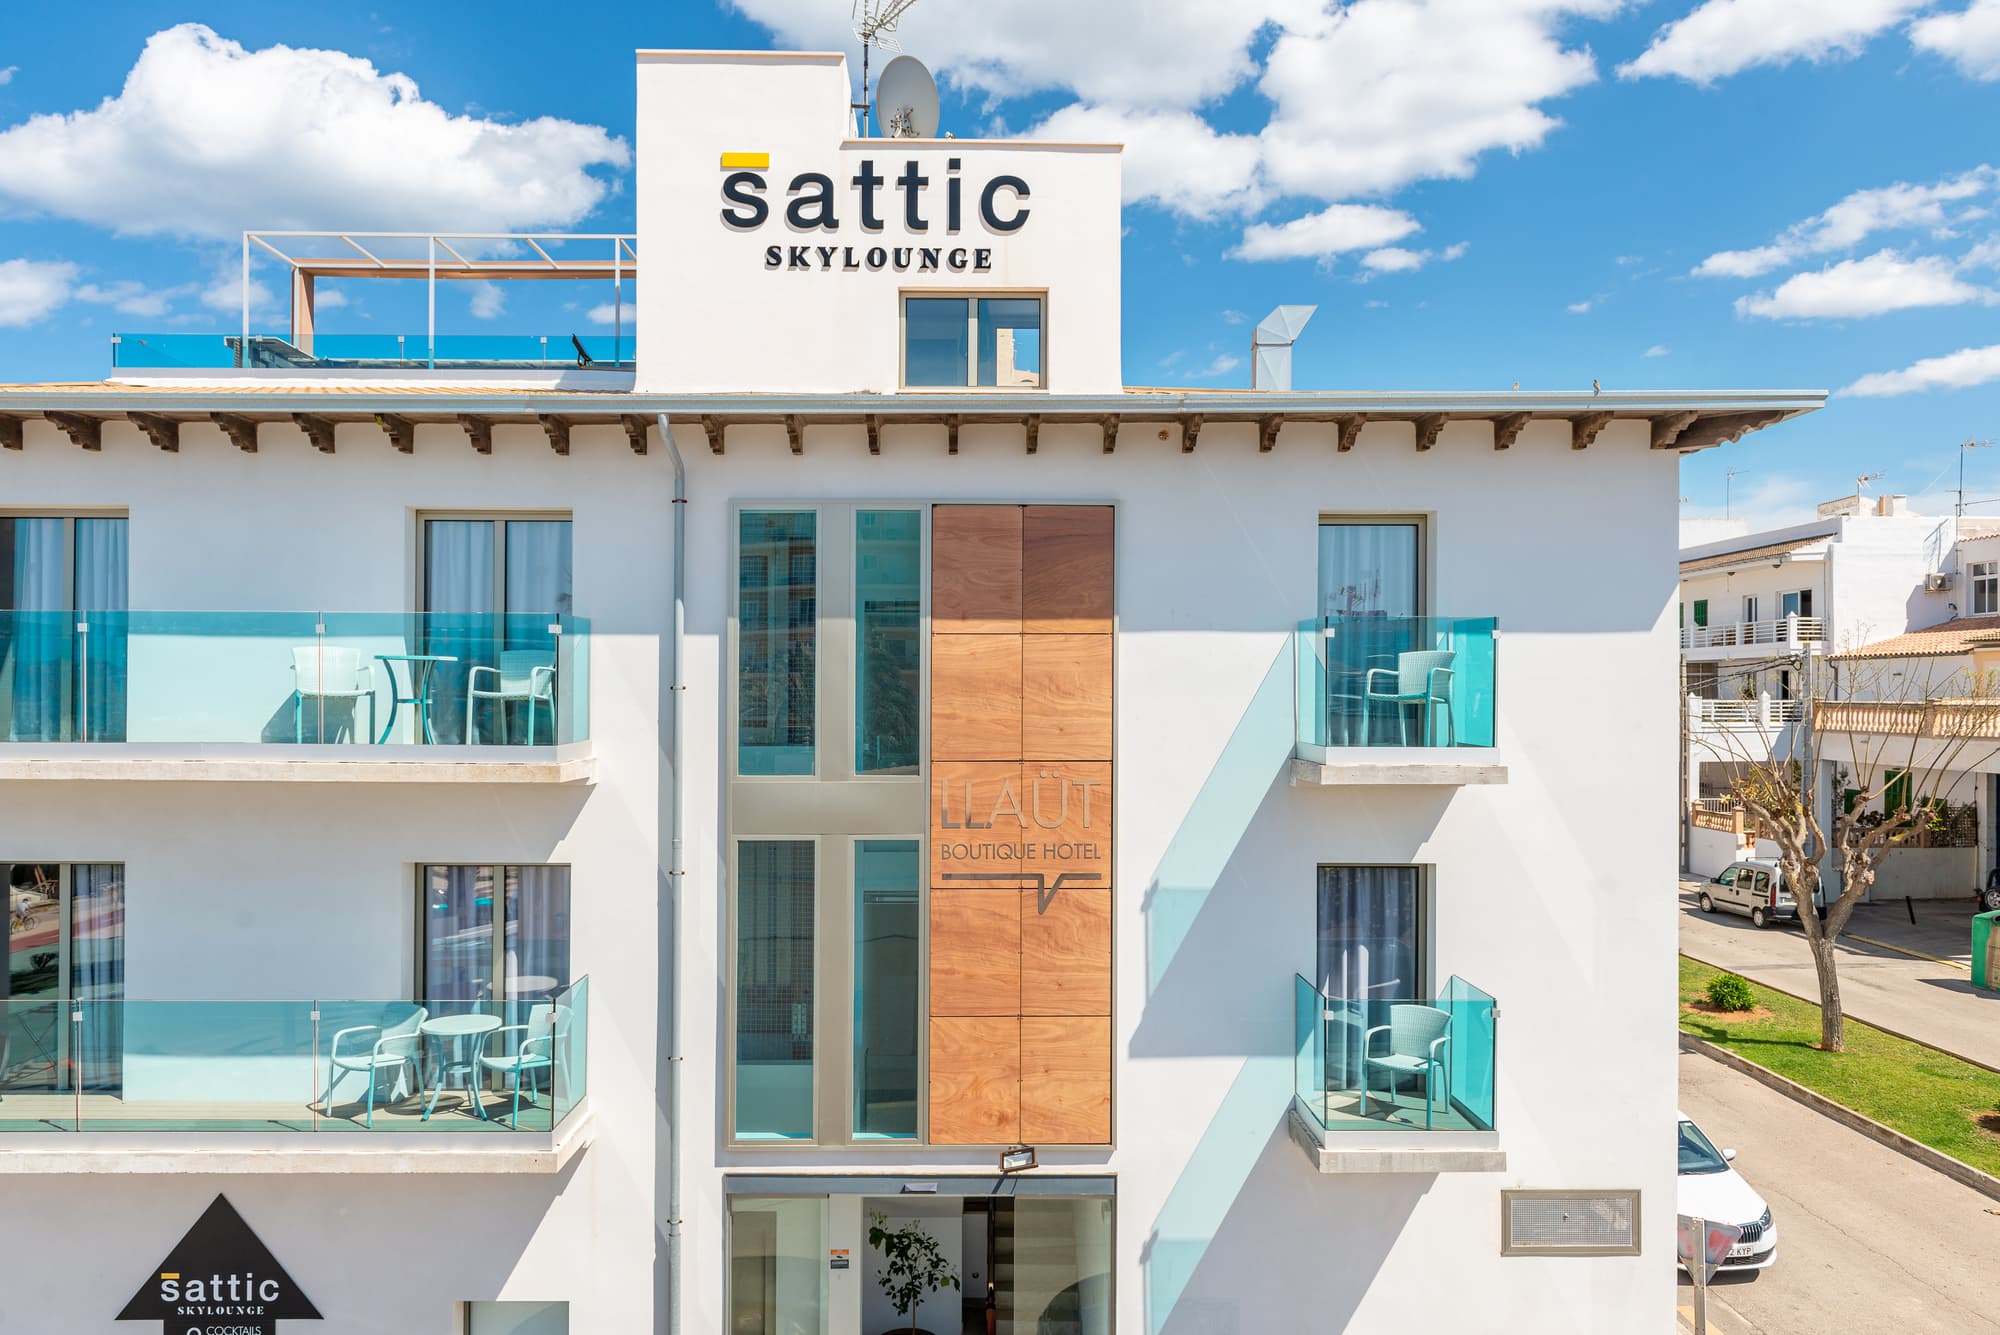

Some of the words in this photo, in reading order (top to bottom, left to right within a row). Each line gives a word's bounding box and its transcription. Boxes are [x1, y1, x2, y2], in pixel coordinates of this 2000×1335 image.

[765, 245, 992, 270] SKYLOUNGE
[941, 770, 1102, 830] LLAÜT
[941, 843, 1036, 860] BOUTIQUE
[1043, 843, 1101, 860] HOTEL
[177, 1305, 264, 1316] SKYLOUNGE
[206, 1326, 262, 1335] COCKTAILS
